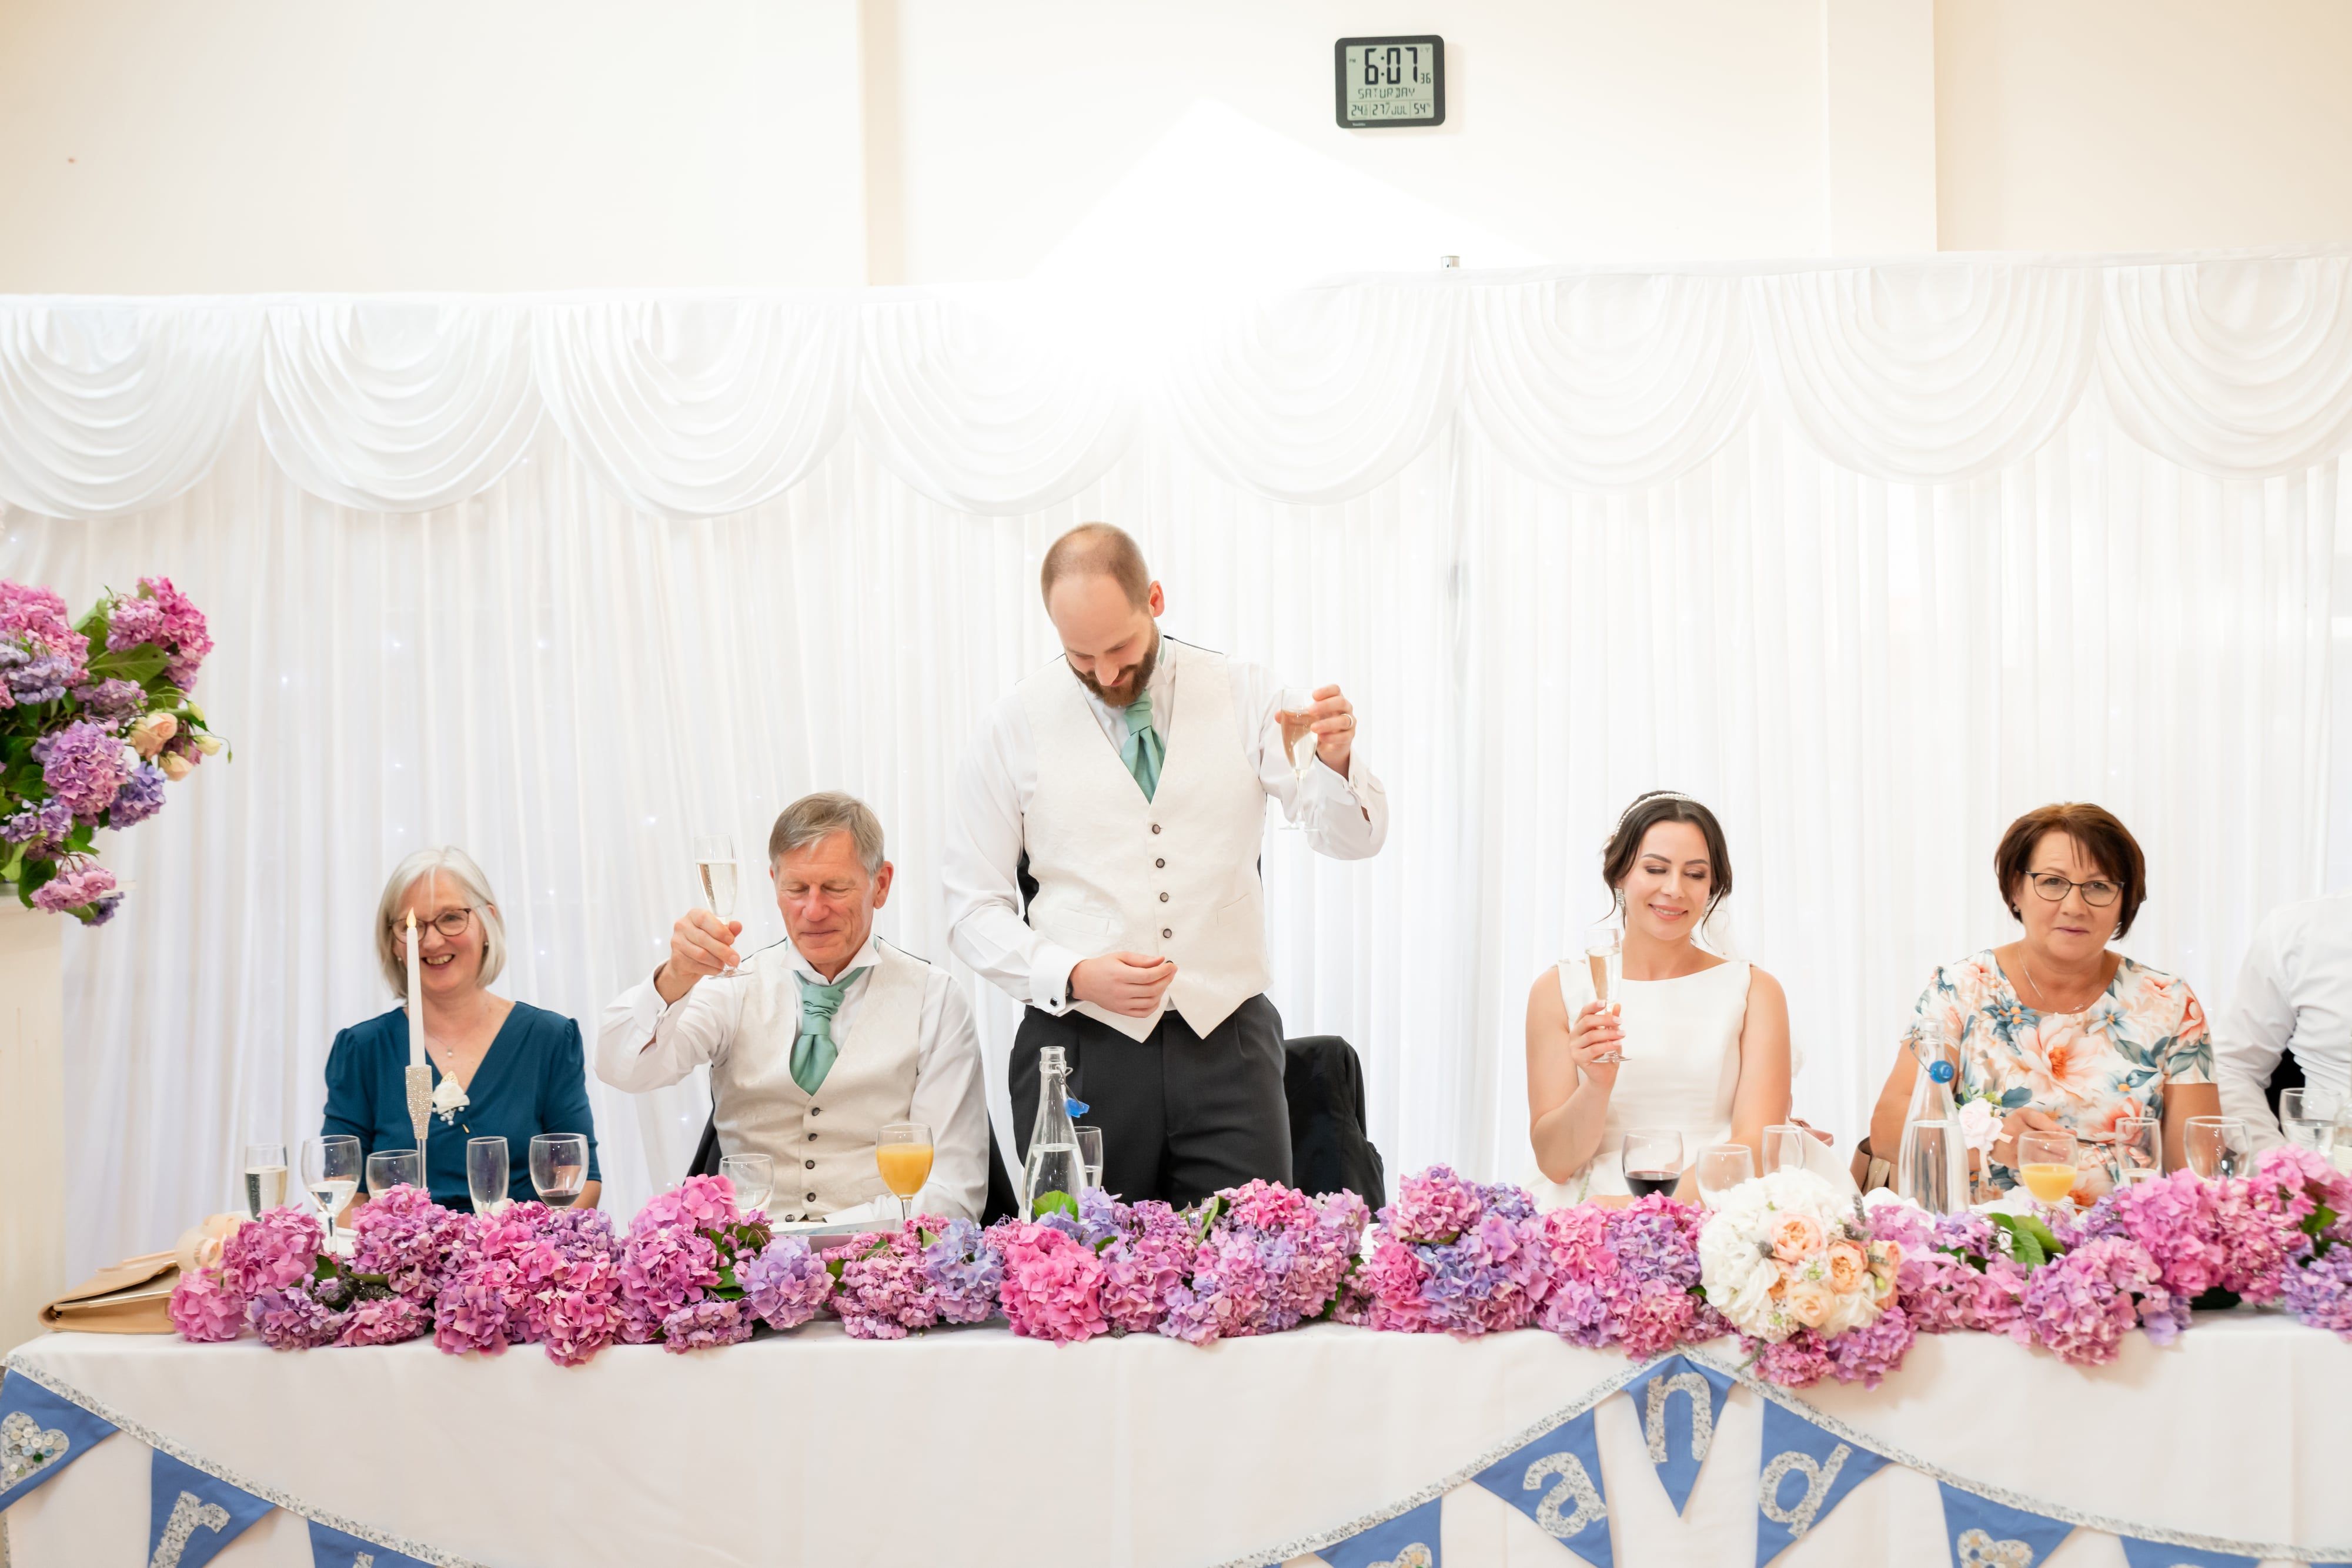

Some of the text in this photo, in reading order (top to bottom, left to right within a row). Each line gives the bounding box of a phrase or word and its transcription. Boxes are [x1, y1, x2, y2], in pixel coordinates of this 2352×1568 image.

[1365, 47, 1418, 85] 6:07
[1420, 73, 1431, 84] 36
[1358, 88, 1415, 99] SATURDAY
